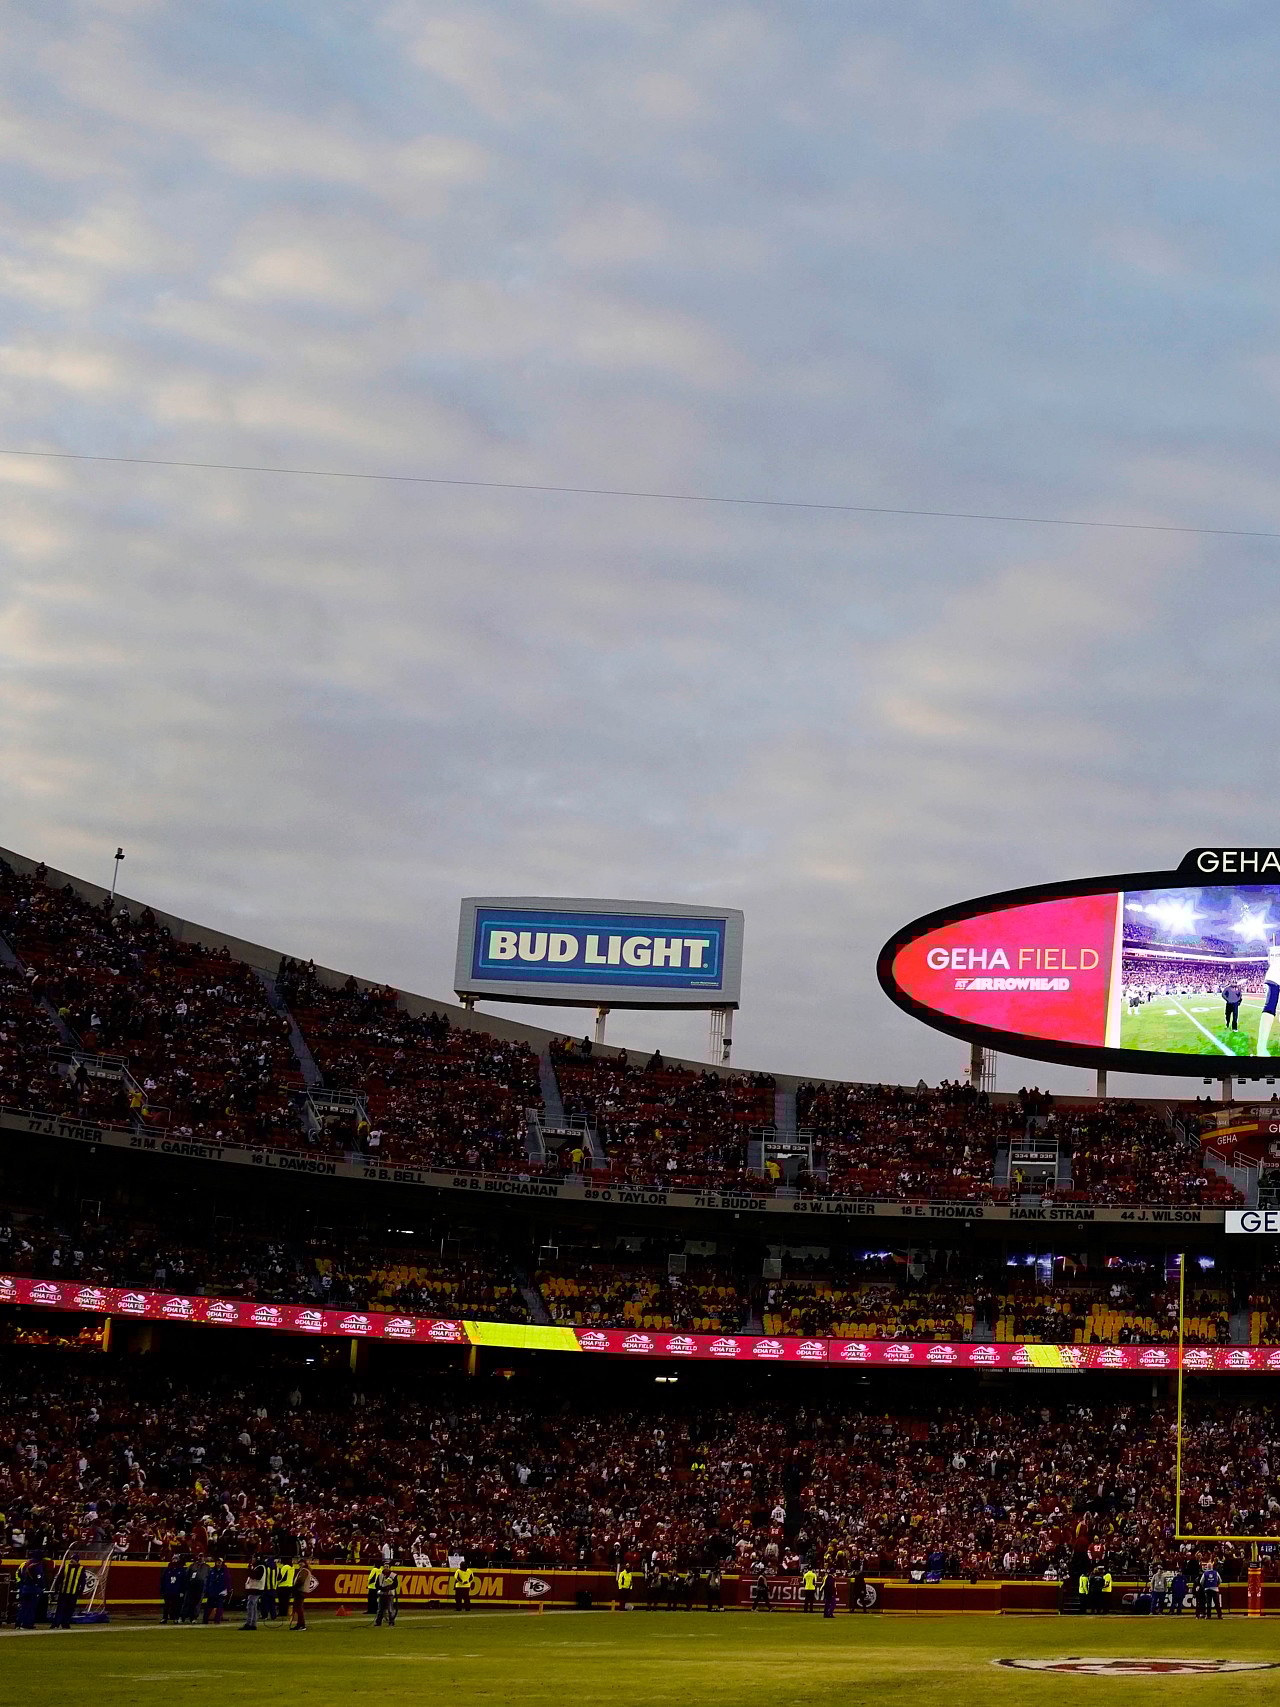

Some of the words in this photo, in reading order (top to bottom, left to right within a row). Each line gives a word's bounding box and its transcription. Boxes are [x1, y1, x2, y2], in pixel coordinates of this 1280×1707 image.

[488, 930, 579, 962] BUD
[926, 948, 1010, 970] GEHA
[1018, 948, 1100, 970] FIELD
[954, 978, 968, 990] AT
[967, 978, 1070, 990] ARROWHEAD
[28, 1120, 40, 1131] 77
[44, 1124, 55, 1134] J.
[59, 1125, 102, 1142] TYRER
[1217, 1134, 1238, 1146] GEHA
[130, 1137, 142, 1147] 21
[162, 1141, 224, 1159] GARRETT
[251, 1154, 262, 1164] 16
[266, 1156, 276, 1166] L.
[280, 1158, 336, 1174] DAWSON
[363, 1168, 376, 1178] 78
[379, 1170, 391, 1180] B.
[394, 1171, 425, 1184] BELL
[453, 1177, 466, 1188] 86
[470, 1179, 482, 1190] B.
[484, 1180, 558, 1196] BUCHANAN
[585, 1190, 598, 1199] 89
[618, 1192, 667, 1205] TAYLOR
[694, 1196, 706, 1206] 71
[708, 1197, 720, 1208] E.
[722, 1198, 766, 1210] BUDDE
[794, 1202, 807, 1212] 63
[810, 1202, 824, 1212] W.
[826, 1203, 874, 1214] LANIER
[901, 1206, 912, 1216] 18
[914, 1206, 926, 1216] E.
[929, 1206, 984, 1218] THOMAS
[1010, 1208, 1046, 1220] HANK
[1050, 1209, 1094, 1220] STRAM
[1121, 1211, 1135, 1220] 44
[1138, 1211, 1149, 1221] J.
[1152, 1210, 1200, 1222] WILSON
